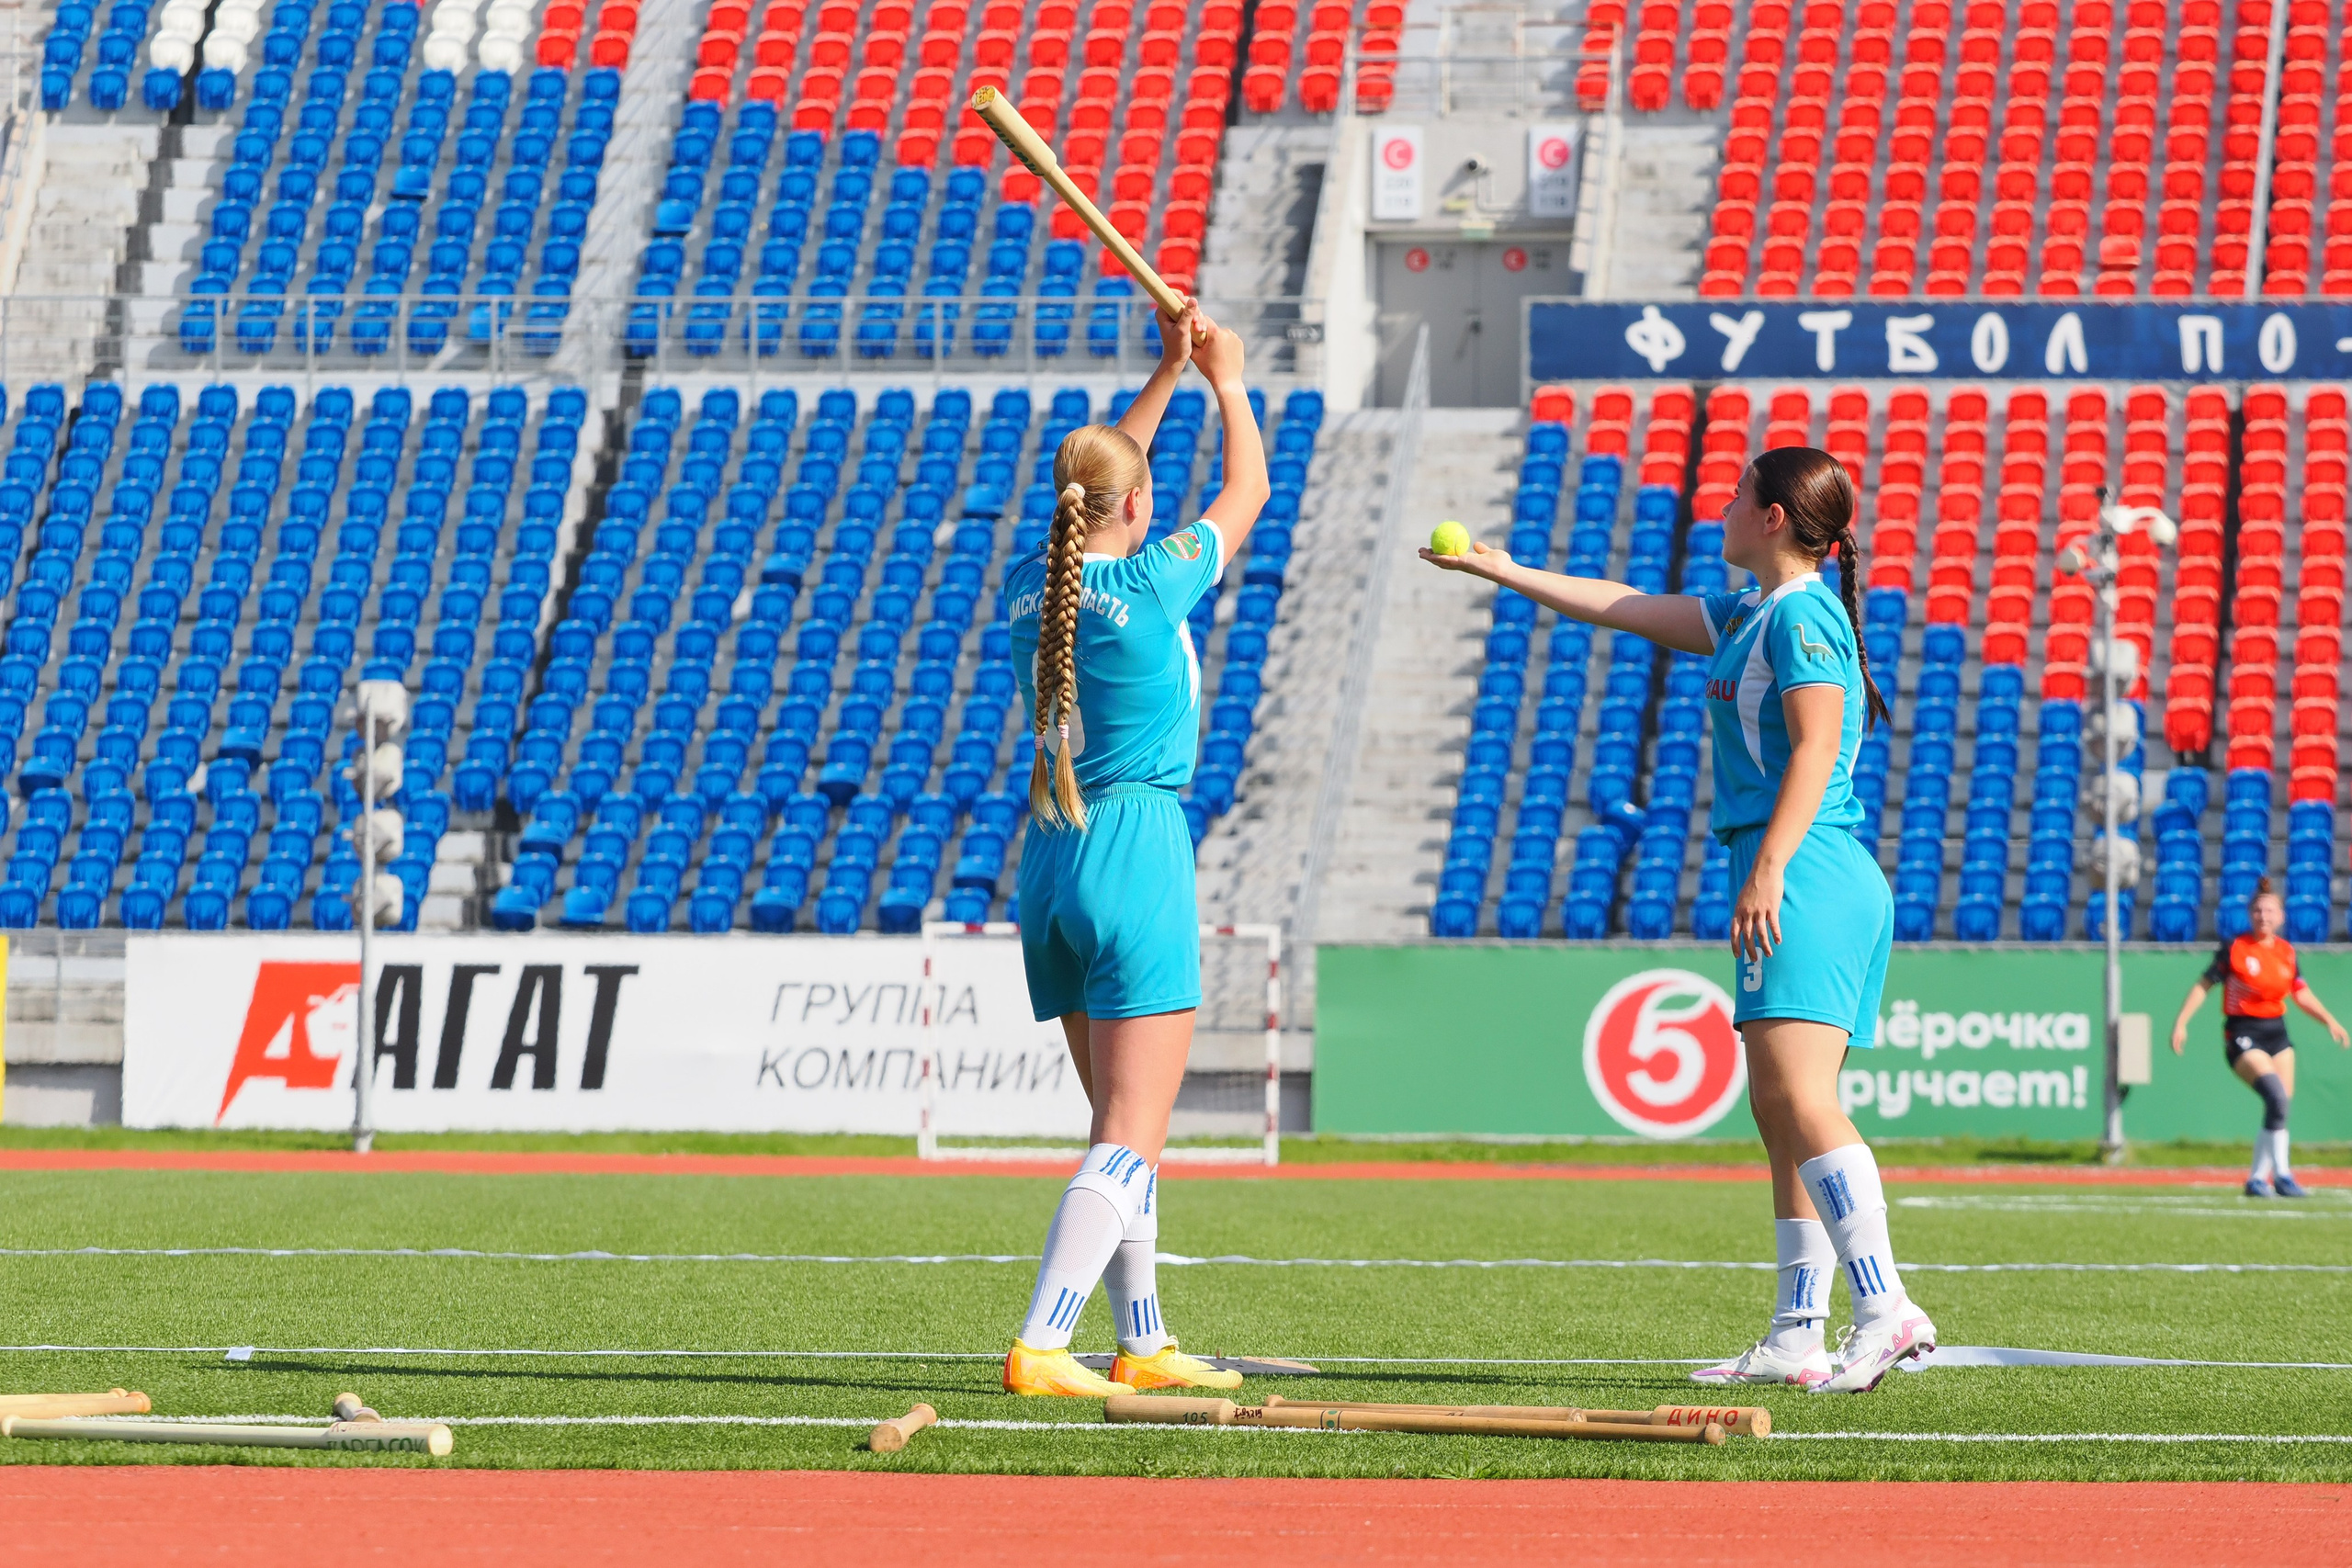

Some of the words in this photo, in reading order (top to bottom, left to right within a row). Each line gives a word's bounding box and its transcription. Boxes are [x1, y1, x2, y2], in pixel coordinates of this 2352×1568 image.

[1625, 305, 2088, 373] ФУТБОЛ
[1080, 587, 1129, 628] ЛАСТЬ
[1743, 946, 1763, 992] 3
[350, 963, 640, 1091] АГАТ
[772, 983, 979, 1025] ГРУППА
[1874, 998, 2090, 1059] ёрочка
[756, 1040, 1067, 1092] КОМПАНИЙ
[1626, 981, 1711, 1107] 5
[1838, 1065, 2089, 1119] ручает!
[1182, 1412, 1208, 1424] 105
[1667, 1408, 1739, 1427] ДИНО
